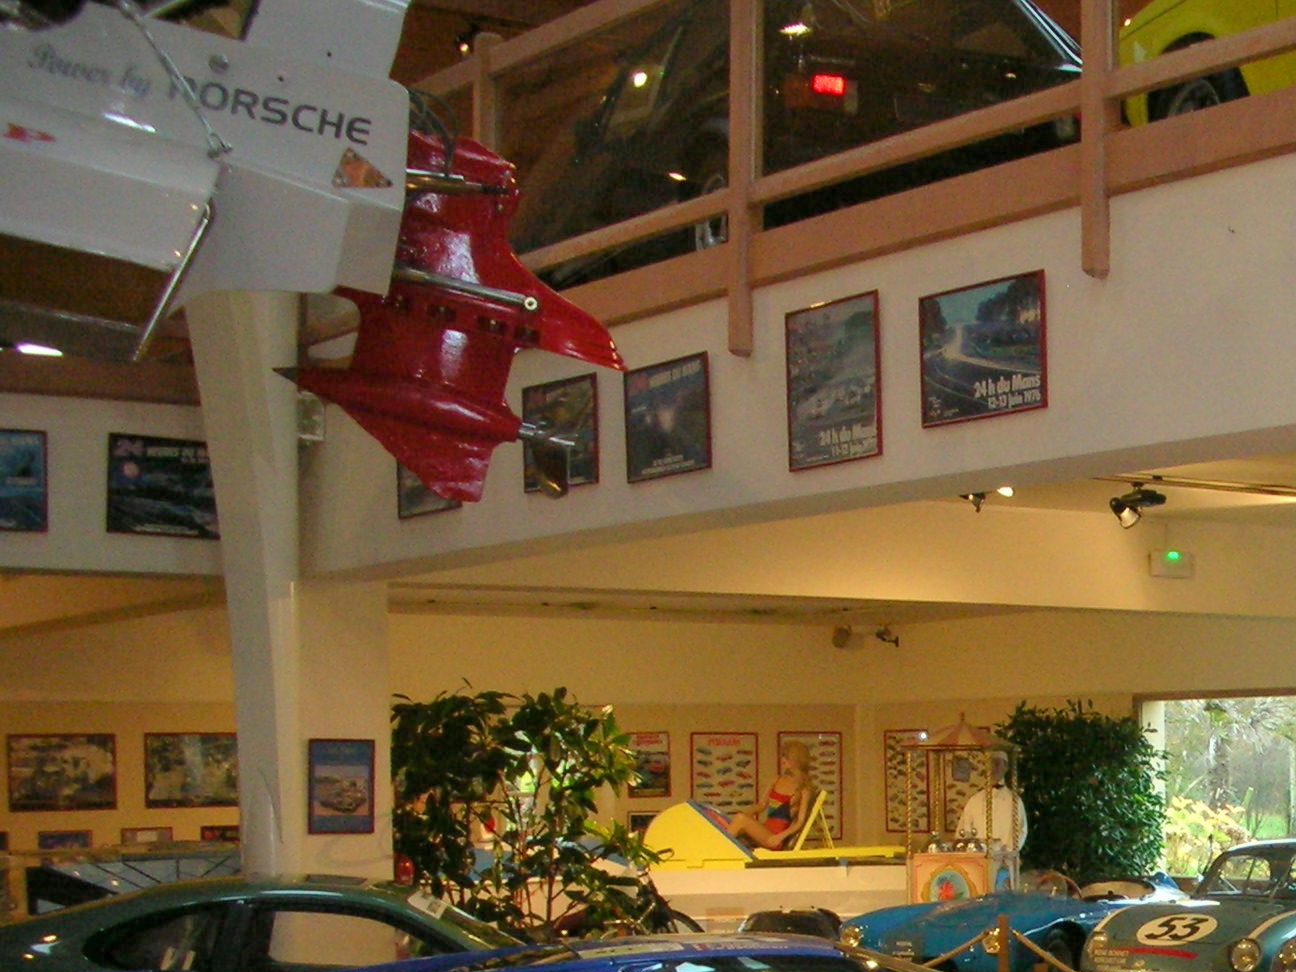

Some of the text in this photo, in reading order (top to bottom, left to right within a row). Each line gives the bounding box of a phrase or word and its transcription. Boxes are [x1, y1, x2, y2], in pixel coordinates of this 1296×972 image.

[168, 75, 372, 146] PORSCHE
[1012, 373, 1041, 392] Mans
[1144, 917, 1209, 941] 53
